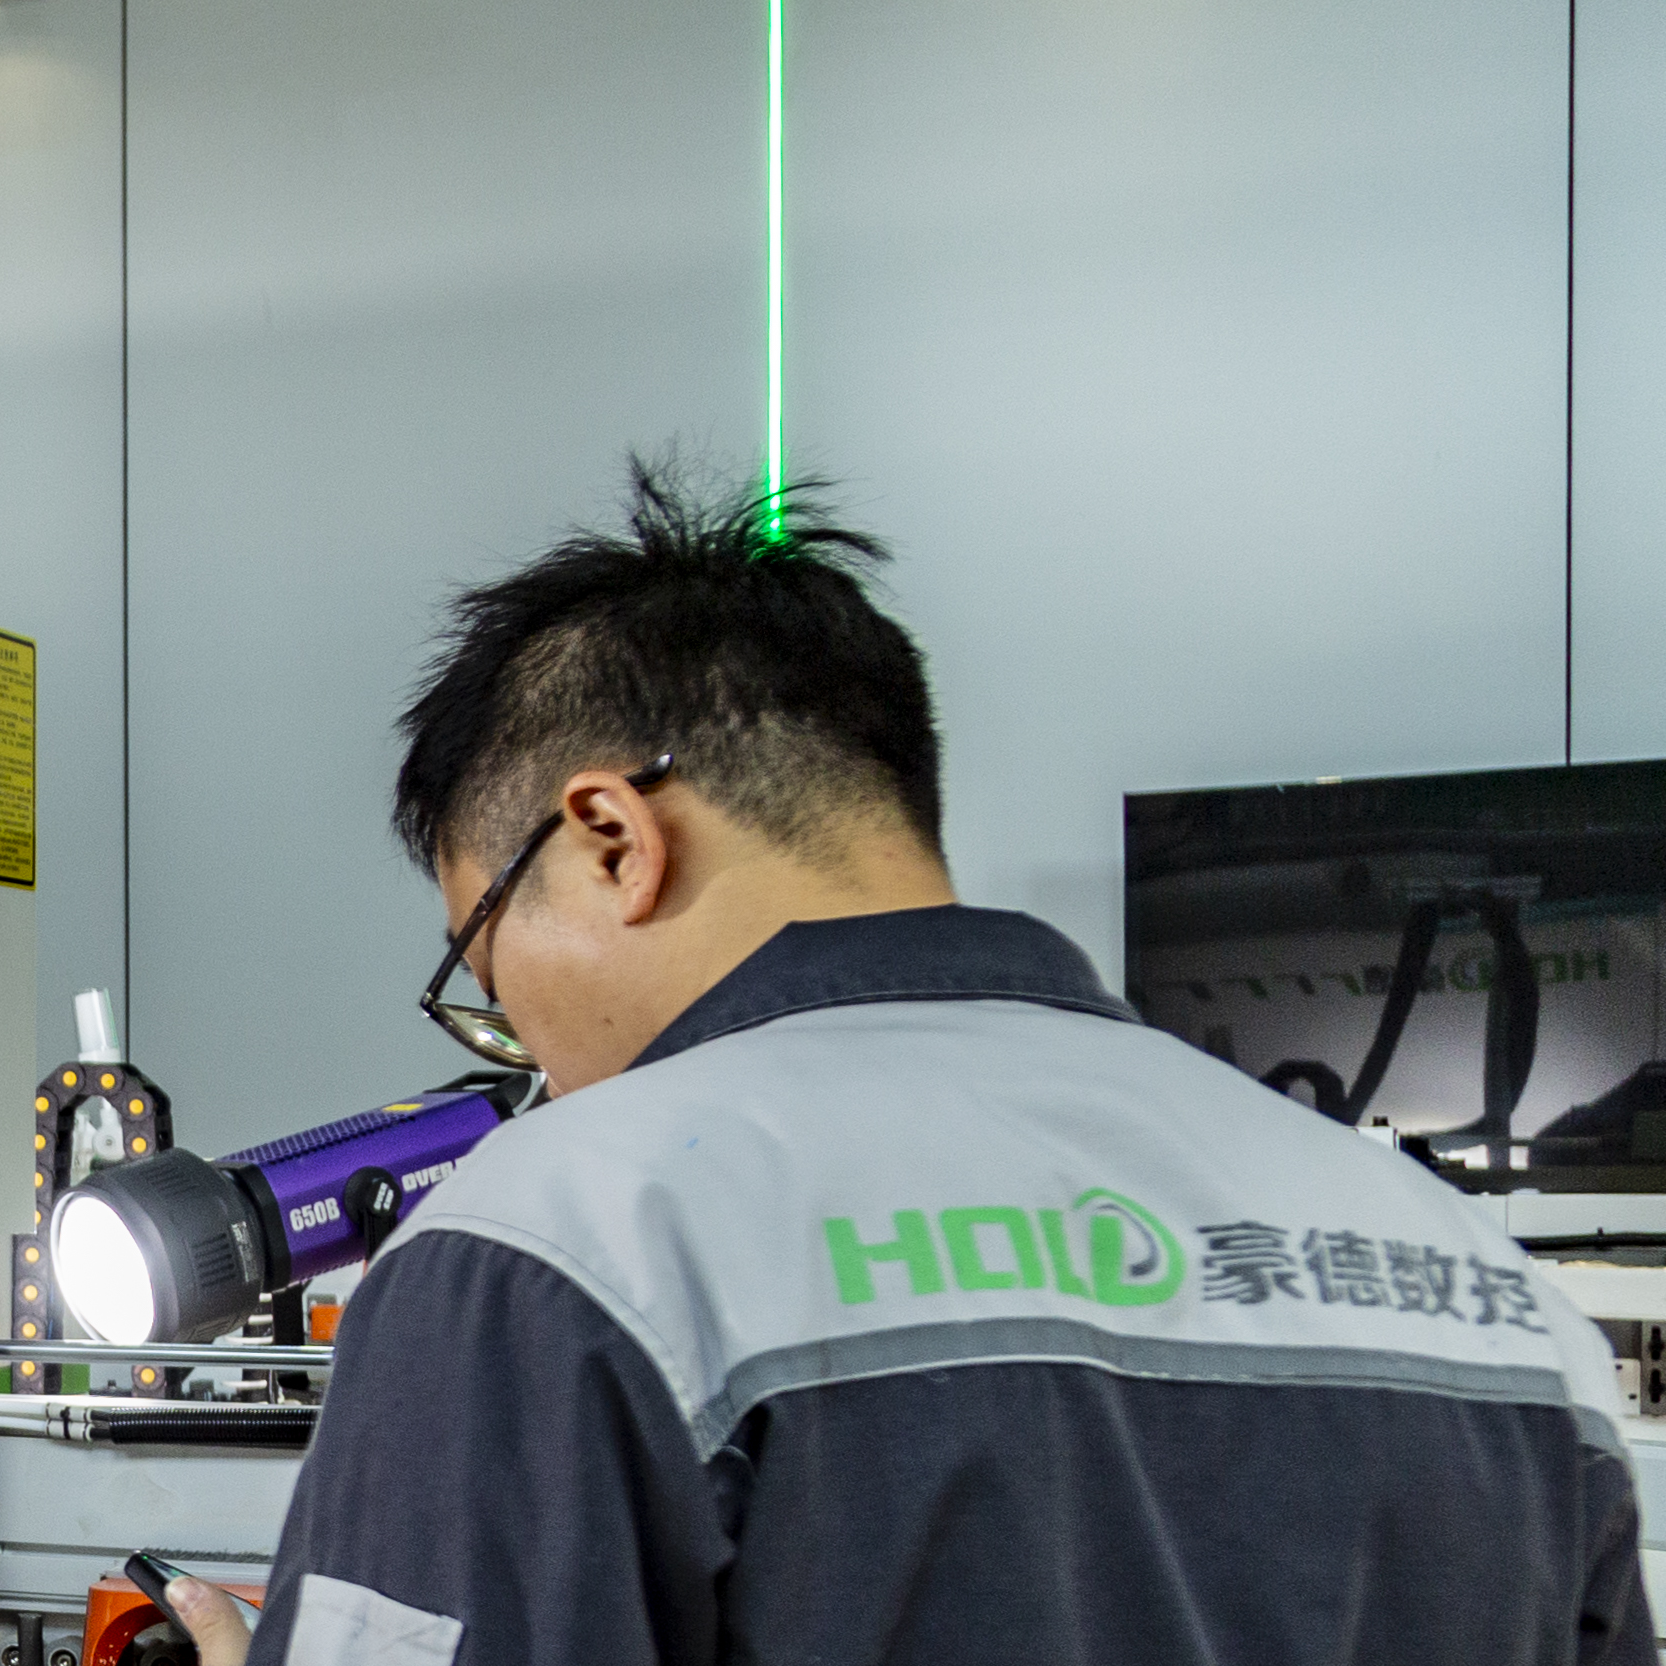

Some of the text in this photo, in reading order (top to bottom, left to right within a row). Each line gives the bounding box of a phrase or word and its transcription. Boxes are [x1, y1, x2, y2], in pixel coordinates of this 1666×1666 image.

[289, 1196, 341, 1233] 650B
[823, 1186, 1551, 1335] HOLD 豪德数控
